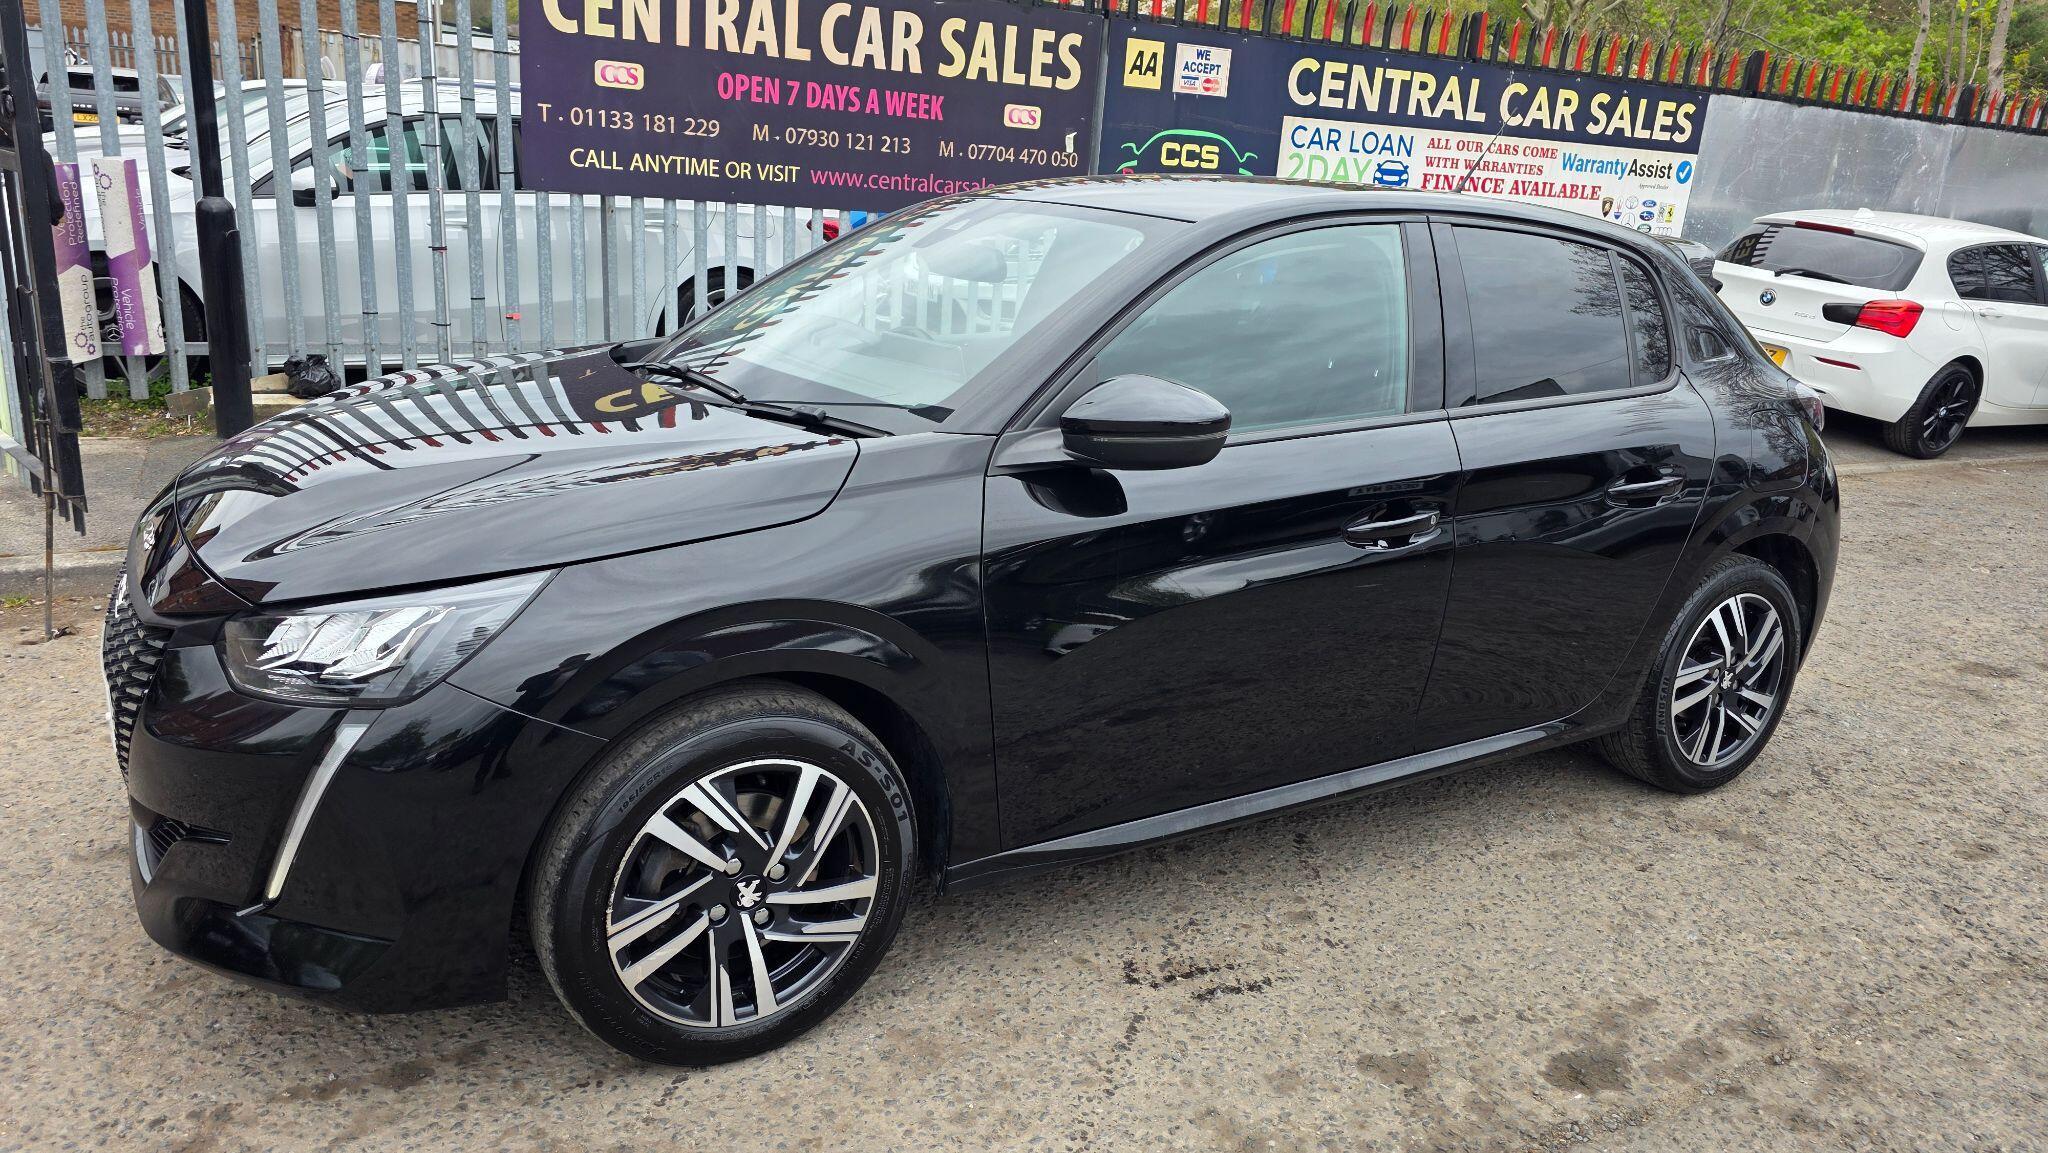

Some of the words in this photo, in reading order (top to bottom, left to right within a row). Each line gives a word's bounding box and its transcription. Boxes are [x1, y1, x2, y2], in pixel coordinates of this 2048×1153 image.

[542, 0, 812, 61] CENTRAL
[820, 2, 923, 74] CAR
[938, 17, 1083, 91] SALES
[1196, 48, 1211, 61] WE
[600, 64, 639, 86] CCS
[1129, 50, 1158, 76] AA
[1183, 61, 1221, 75] ACCEPT
[717, 72, 780, 105] OPEN
[786, 80, 801, 106] 7
[806, 81, 861, 112] DAYS
[865, 88, 880, 115] A
[886, 91, 944, 121] WEEK
[1287, 57, 1486, 123] CENTRAL
[1500, 82, 1579, 132] CAR
[1586, 92, 1697, 143] SALES
[570, 107, 634, 130] 01133
[642, 113, 676, 134] 181
[683, 117, 720, 138] 229
[785, 127, 840, 148] 07930
[846, 132, 873, 151] 121
[880, 135, 911, 154] 213
[968, 143, 1015, 163] 07704
[1019, 148, 1047, 166] 470
[1051, 151, 1079, 168] 050
[1160, 141, 1220, 169] CCS
[1291, 125, 1342, 151] CAR
[1349, 130, 1414, 157] LOAN
[1427, 137, 1452, 151] ALL
[1456, 139, 1484, 153] OUR
[1488, 142, 1520, 156] CARS
[1522, 145, 1559, 160] COME
[569, 148, 624, 171] CALL
[629, 153, 720, 178] ANYTIME
[725, 161, 752, 180] OR
[757, 162, 801, 183] VISIT
[1287, 152, 1373, 182] 2DAY
[1425, 155, 1461, 170] WITH
[1464, 158, 1544, 176] WARRANTIES
[1421, 172, 1505, 195] FINANCE
[1508, 179, 1602, 201] AVAILABLE
[62, 181, 78, 246] Protection
[69, 181, 85, 244] Redefined
[81, 274, 95, 342] autogroup
[112, 277, 125, 339] Protection
[121, 288, 135, 330] Vehicle
[838, 740, 909, 822] AS-S01
